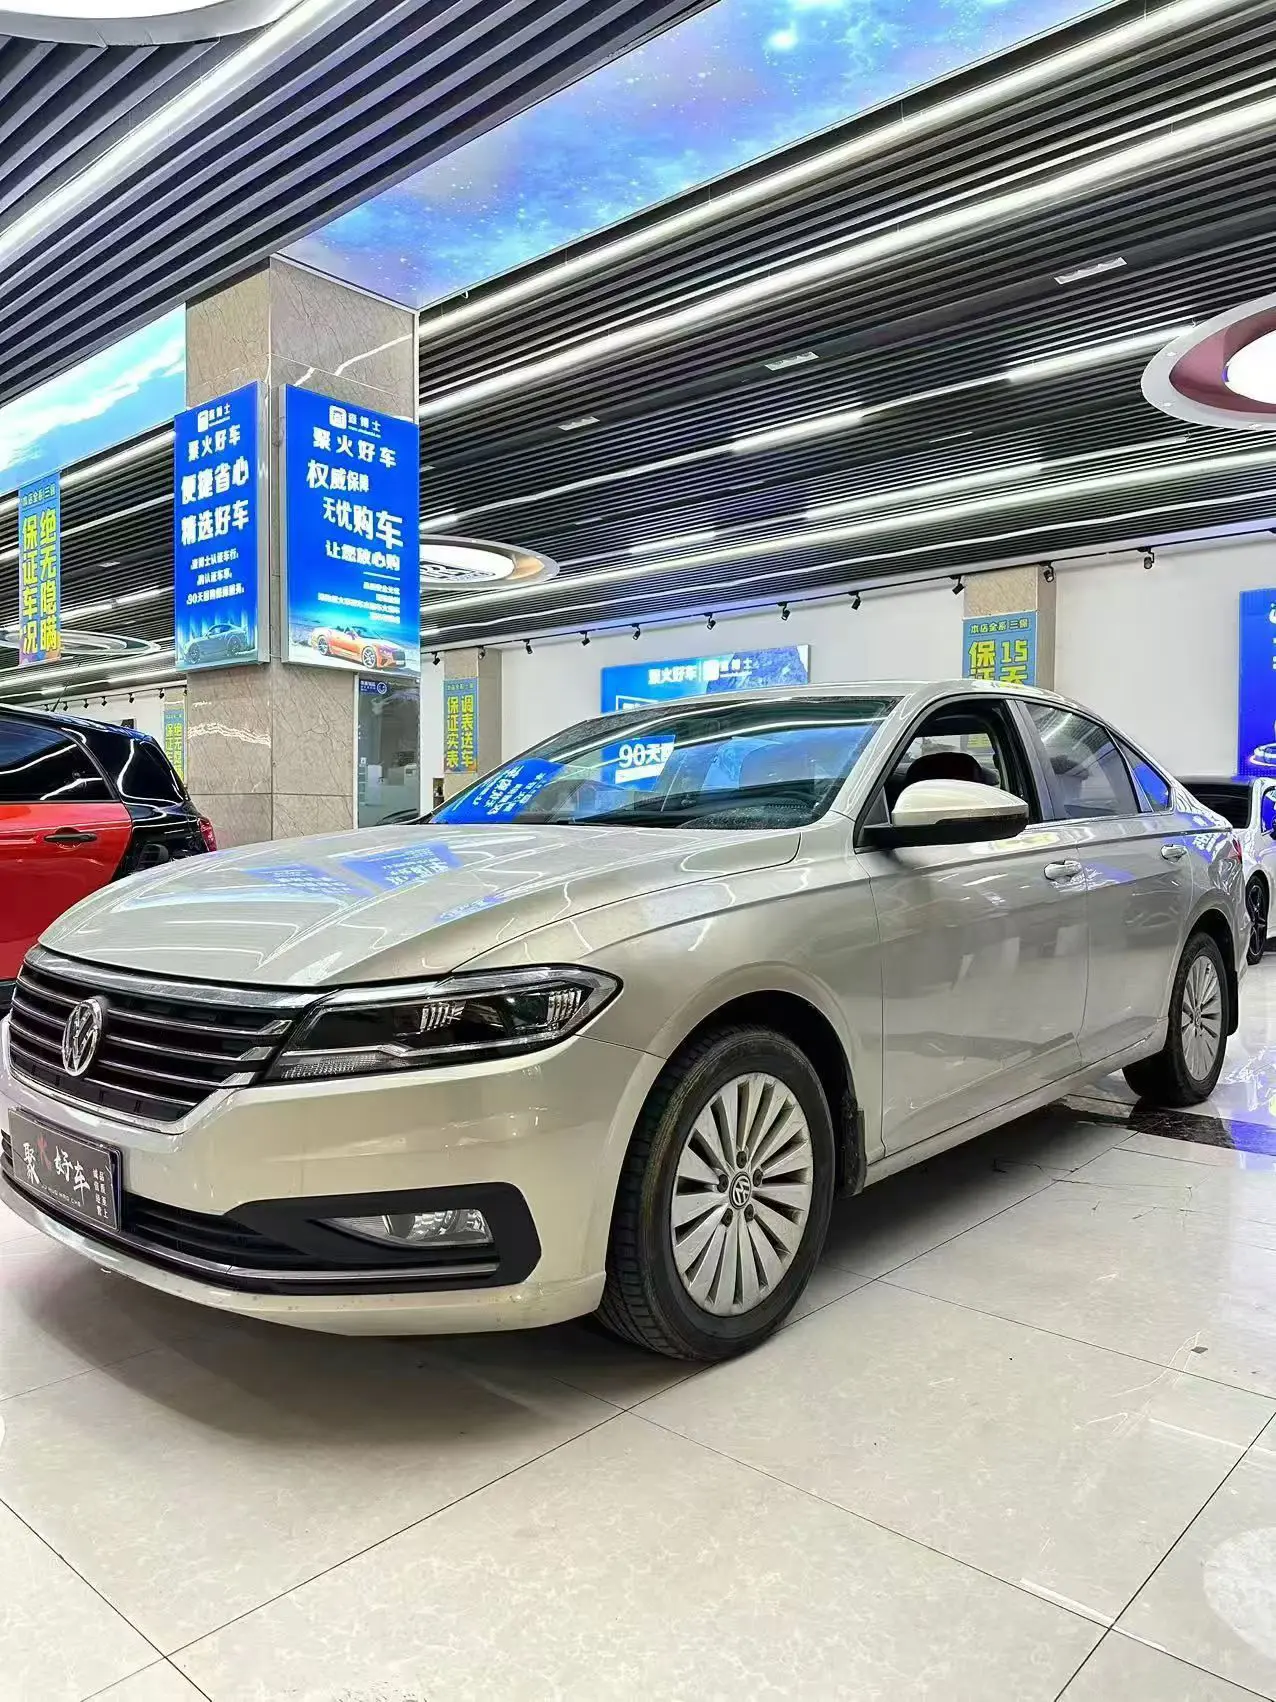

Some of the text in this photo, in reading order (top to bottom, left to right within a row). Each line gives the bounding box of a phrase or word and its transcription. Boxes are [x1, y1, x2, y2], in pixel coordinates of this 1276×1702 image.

[313, 427, 396, 468] 聚火好车
[181, 456, 249, 505] 便捷省心
[306, 459, 369, 492] 权威保障
[181, 500, 249, 546] 精选好车
[323, 497, 404, 549] 无忧购车
[325, 540, 400, 571] 让您放心购
[22, 515, 38, 654] 保证车况
[40, 508, 57, 652] 绝无隐瞒
